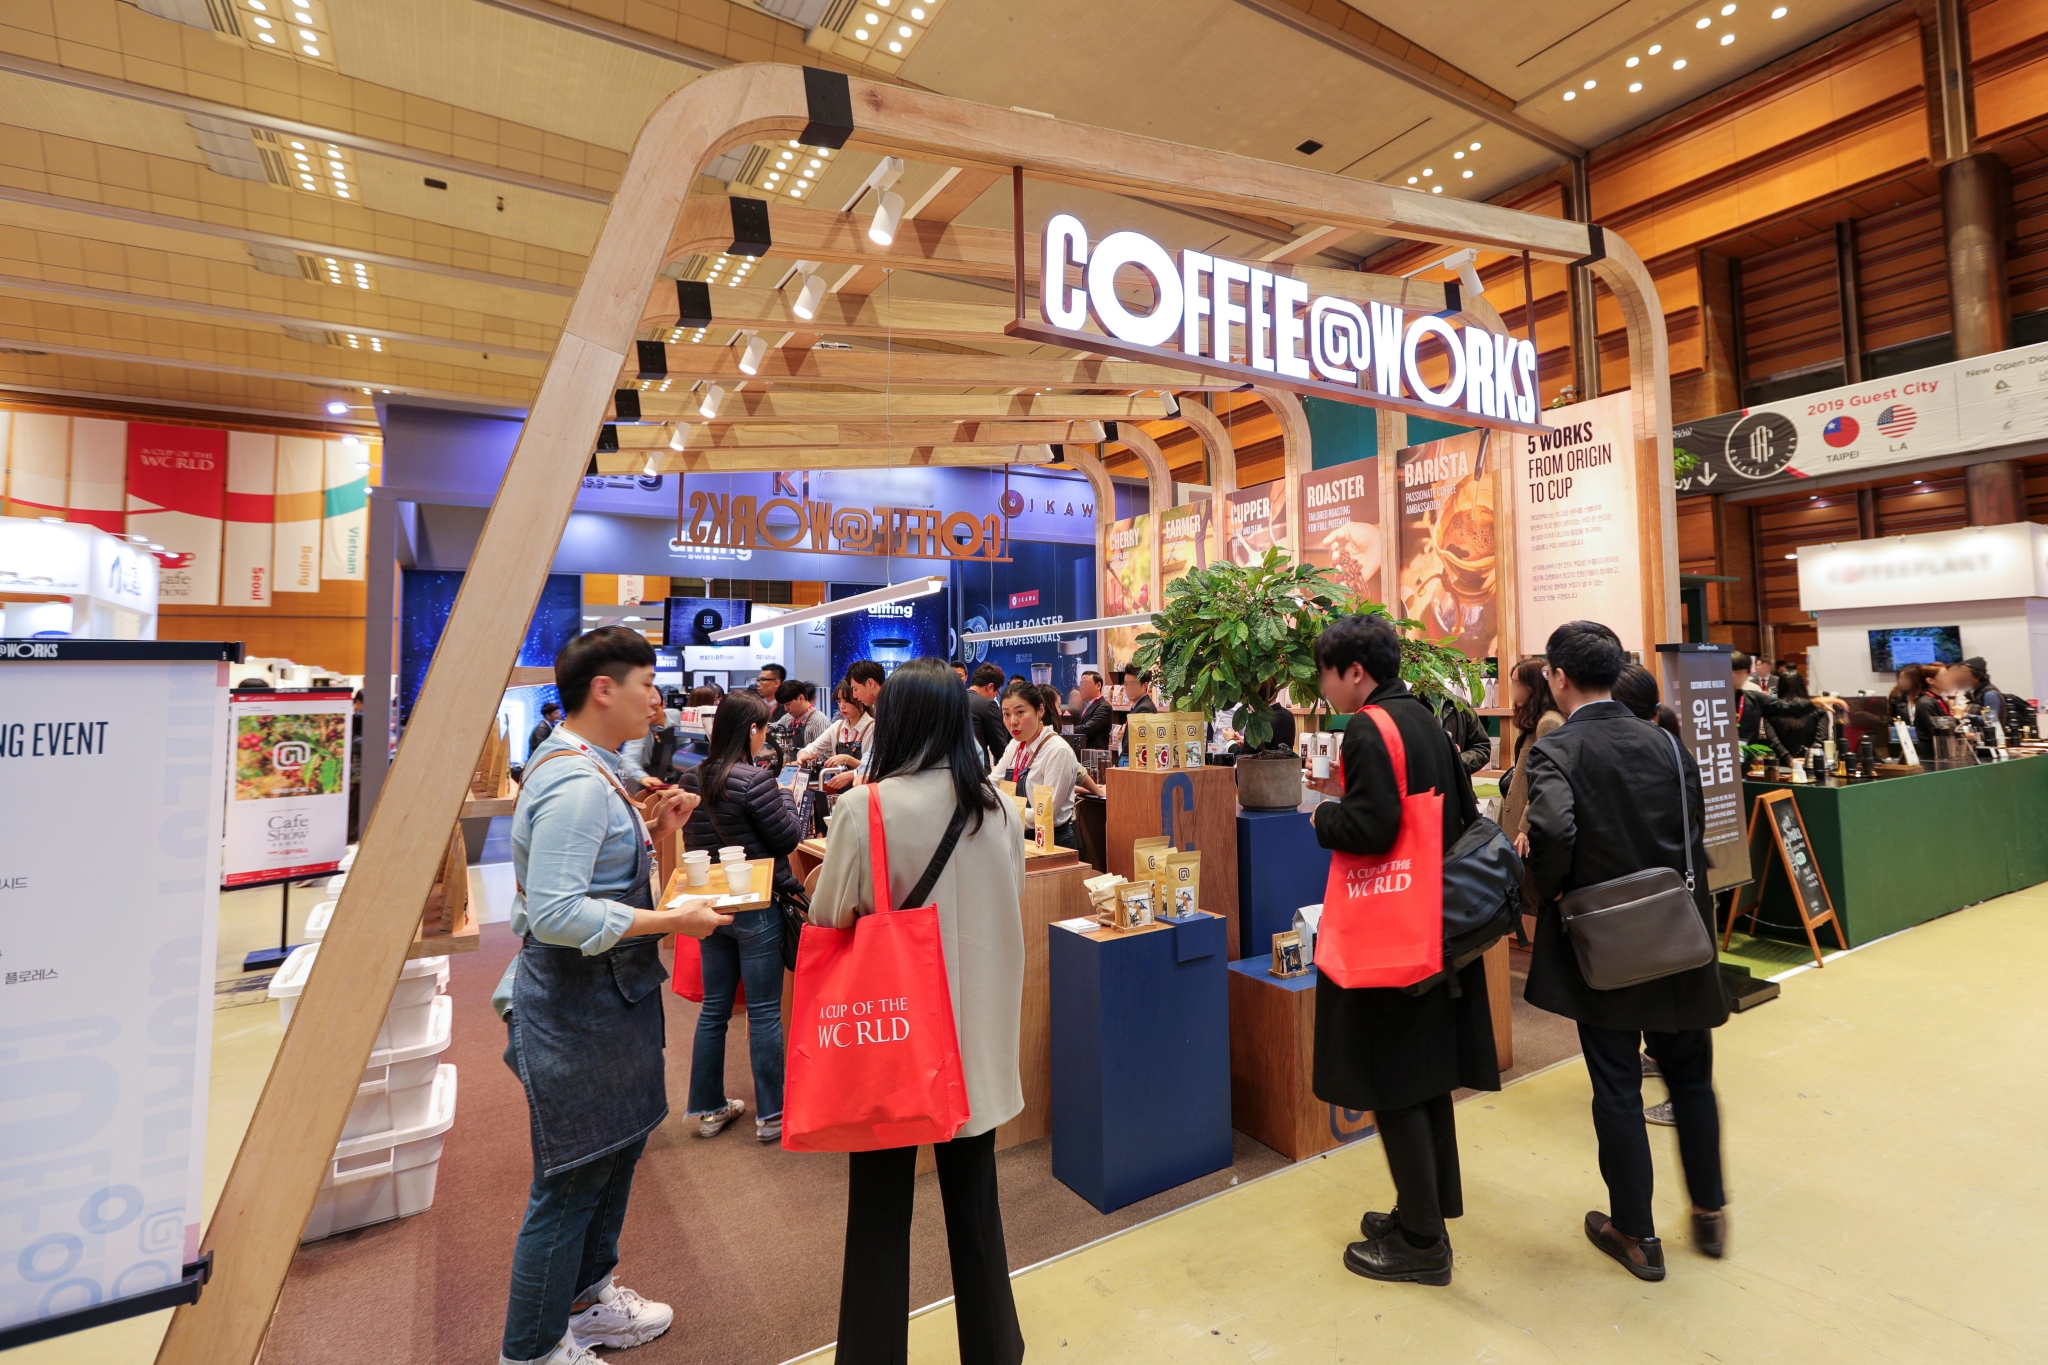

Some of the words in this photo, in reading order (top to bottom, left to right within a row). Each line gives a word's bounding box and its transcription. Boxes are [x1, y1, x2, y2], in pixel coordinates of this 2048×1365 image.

[1041, 214, 1536, 423] COFFEE@WORKS
[1965, 367, 1991, 378] New
[1993, 359, 2026, 371] Open
[1807, 399, 1844, 416] 2019
[1849, 388, 1898, 406] Guest
[1903, 380, 1940, 396] City
[1528, 435, 1536, 455] 5
[1540, 421, 1593, 452] WORKS
[1528, 453, 1563, 479] FROM
[1567, 442, 1612, 471] ORIGIN
[1826, 450, 1860, 463] TAIPEI
[1404, 450, 1469, 488] BARISTA
[1307, 474, 1365, 508] ROASTER
[1406, 488, 1437, 503] PASSIONATE
[1529, 482, 1544, 504] TO
[1548, 477, 1573, 501] CUP
[1029, 498, 1094, 518] IKAW
[1230, 497, 1270, 525] CUPPER
[1328, 505, 1350, 518] ROASTING
[1405, 499, 1441, 515] AMBASSADOR
[1165, 514, 1201, 540] FARMER
[1308, 523, 1317, 532] FOR
[1317, 521, 1327, 531] FULL
[346, 527, 360, 574] Vietnam
[1109, 528, 1139, 551] CHERRY
[298, 545, 313, 586] Beijing
[159, 585, 192, 597] how
[251, 567, 265, 600] Seoul
[1018, 595, 1036, 603] IKAWA
[989, 619, 1020, 632] SAMPLE
[991, 638, 1004, 648] FOR
[1005, 632, 1062, 647] PROFESSIONALS
[1692, 698, 1730, 741] 원두
[32, 721, 109, 757] EVENT
[1696, 742, 1734, 787] 납품
[267, 814, 310, 830] Cafe
[267, 829, 310, 842] Show
[1346, 869, 1355, 880] A
[1357, 867, 1377, 879] CUP
[1376, 863, 1389, 874] OF
[1389, 858, 1412, 871] THE
[1346, 872, 1412, 900] WORLD
[5, 968, 59, 985] 플로레스
[819, 1006, 824, 1019] A
[825, 1004, 848, 1019] CUP
[852, 1000, 874, 1016] OF
[878, 997, 908, 1013] THE
[818, 1016, 910, 1049] WORLD
